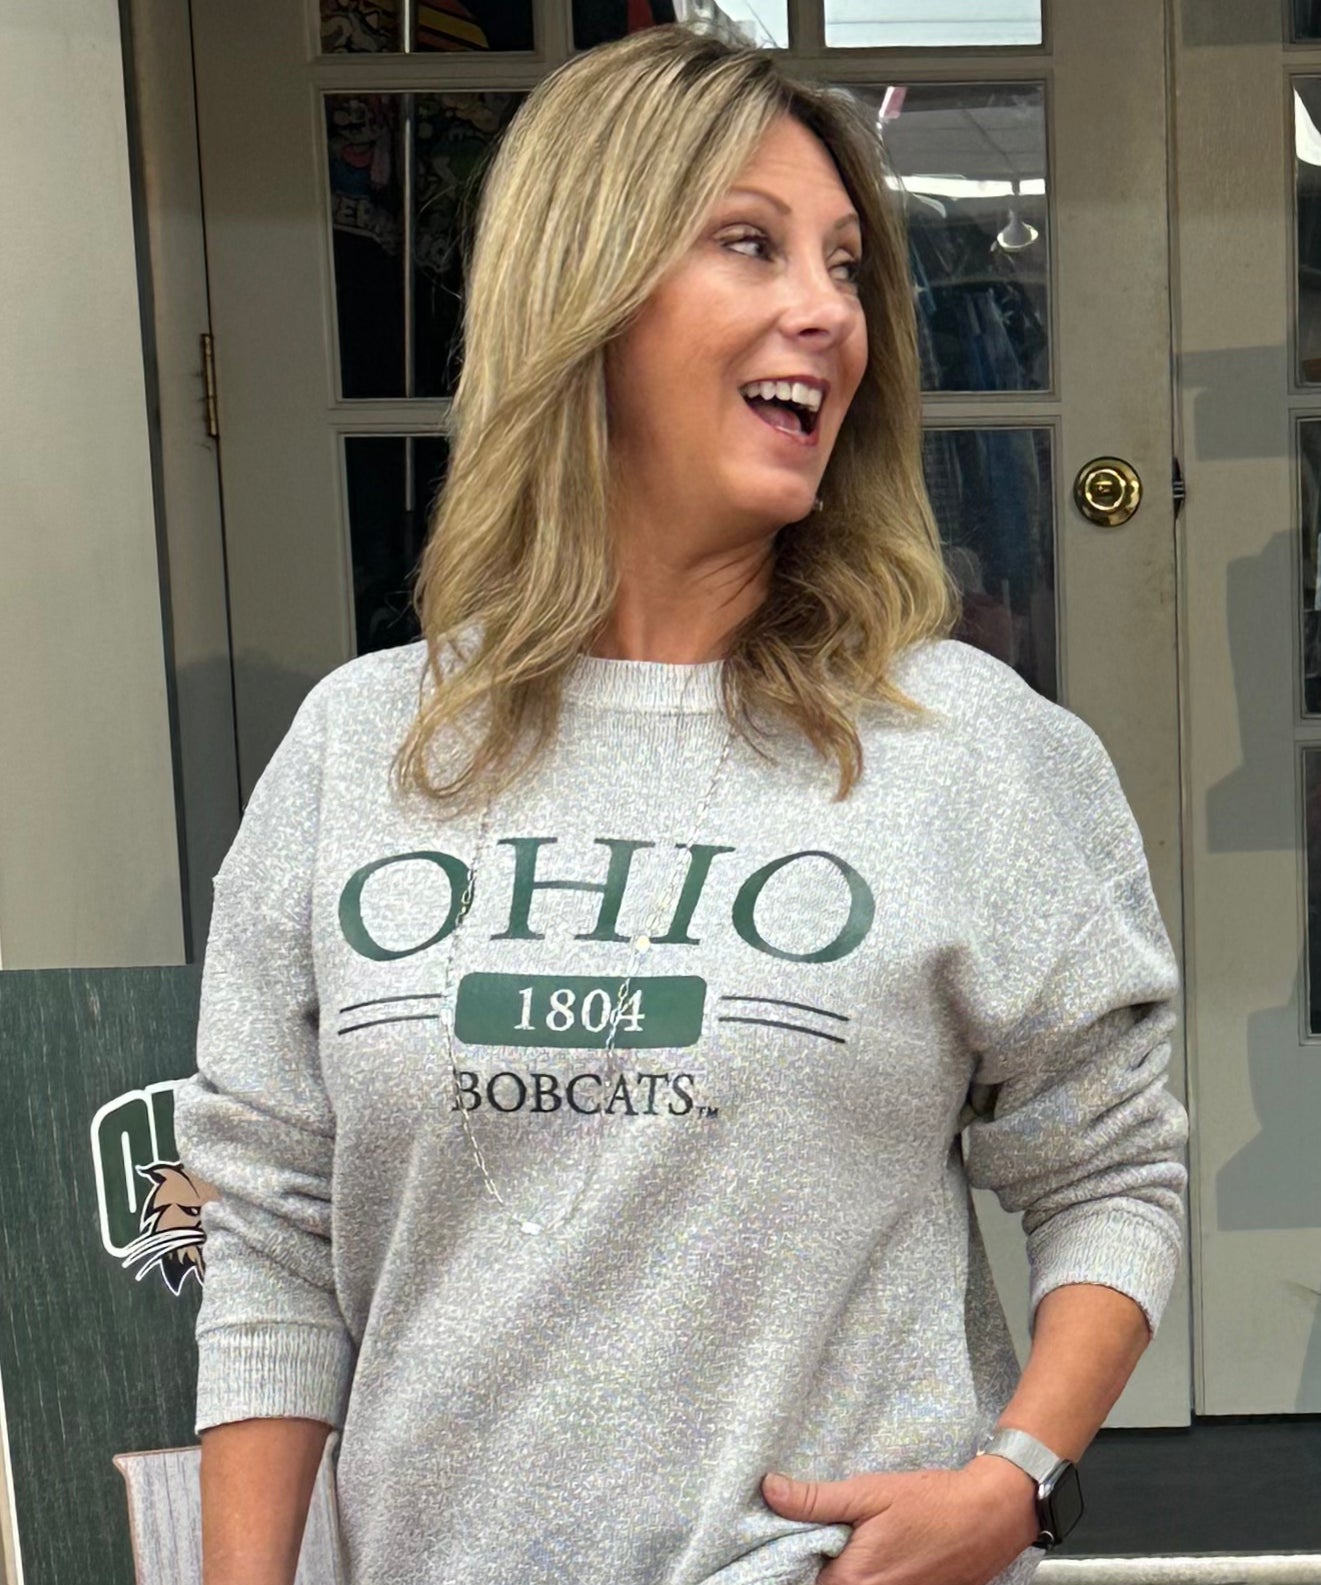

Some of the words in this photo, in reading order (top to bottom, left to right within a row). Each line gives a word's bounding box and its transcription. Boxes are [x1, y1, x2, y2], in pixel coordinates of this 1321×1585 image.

[337, 836, 876, 964] OHIO
[513, 986, 646, 1034] 1804
[452, 1070, 695, 1116] BOBCATS
